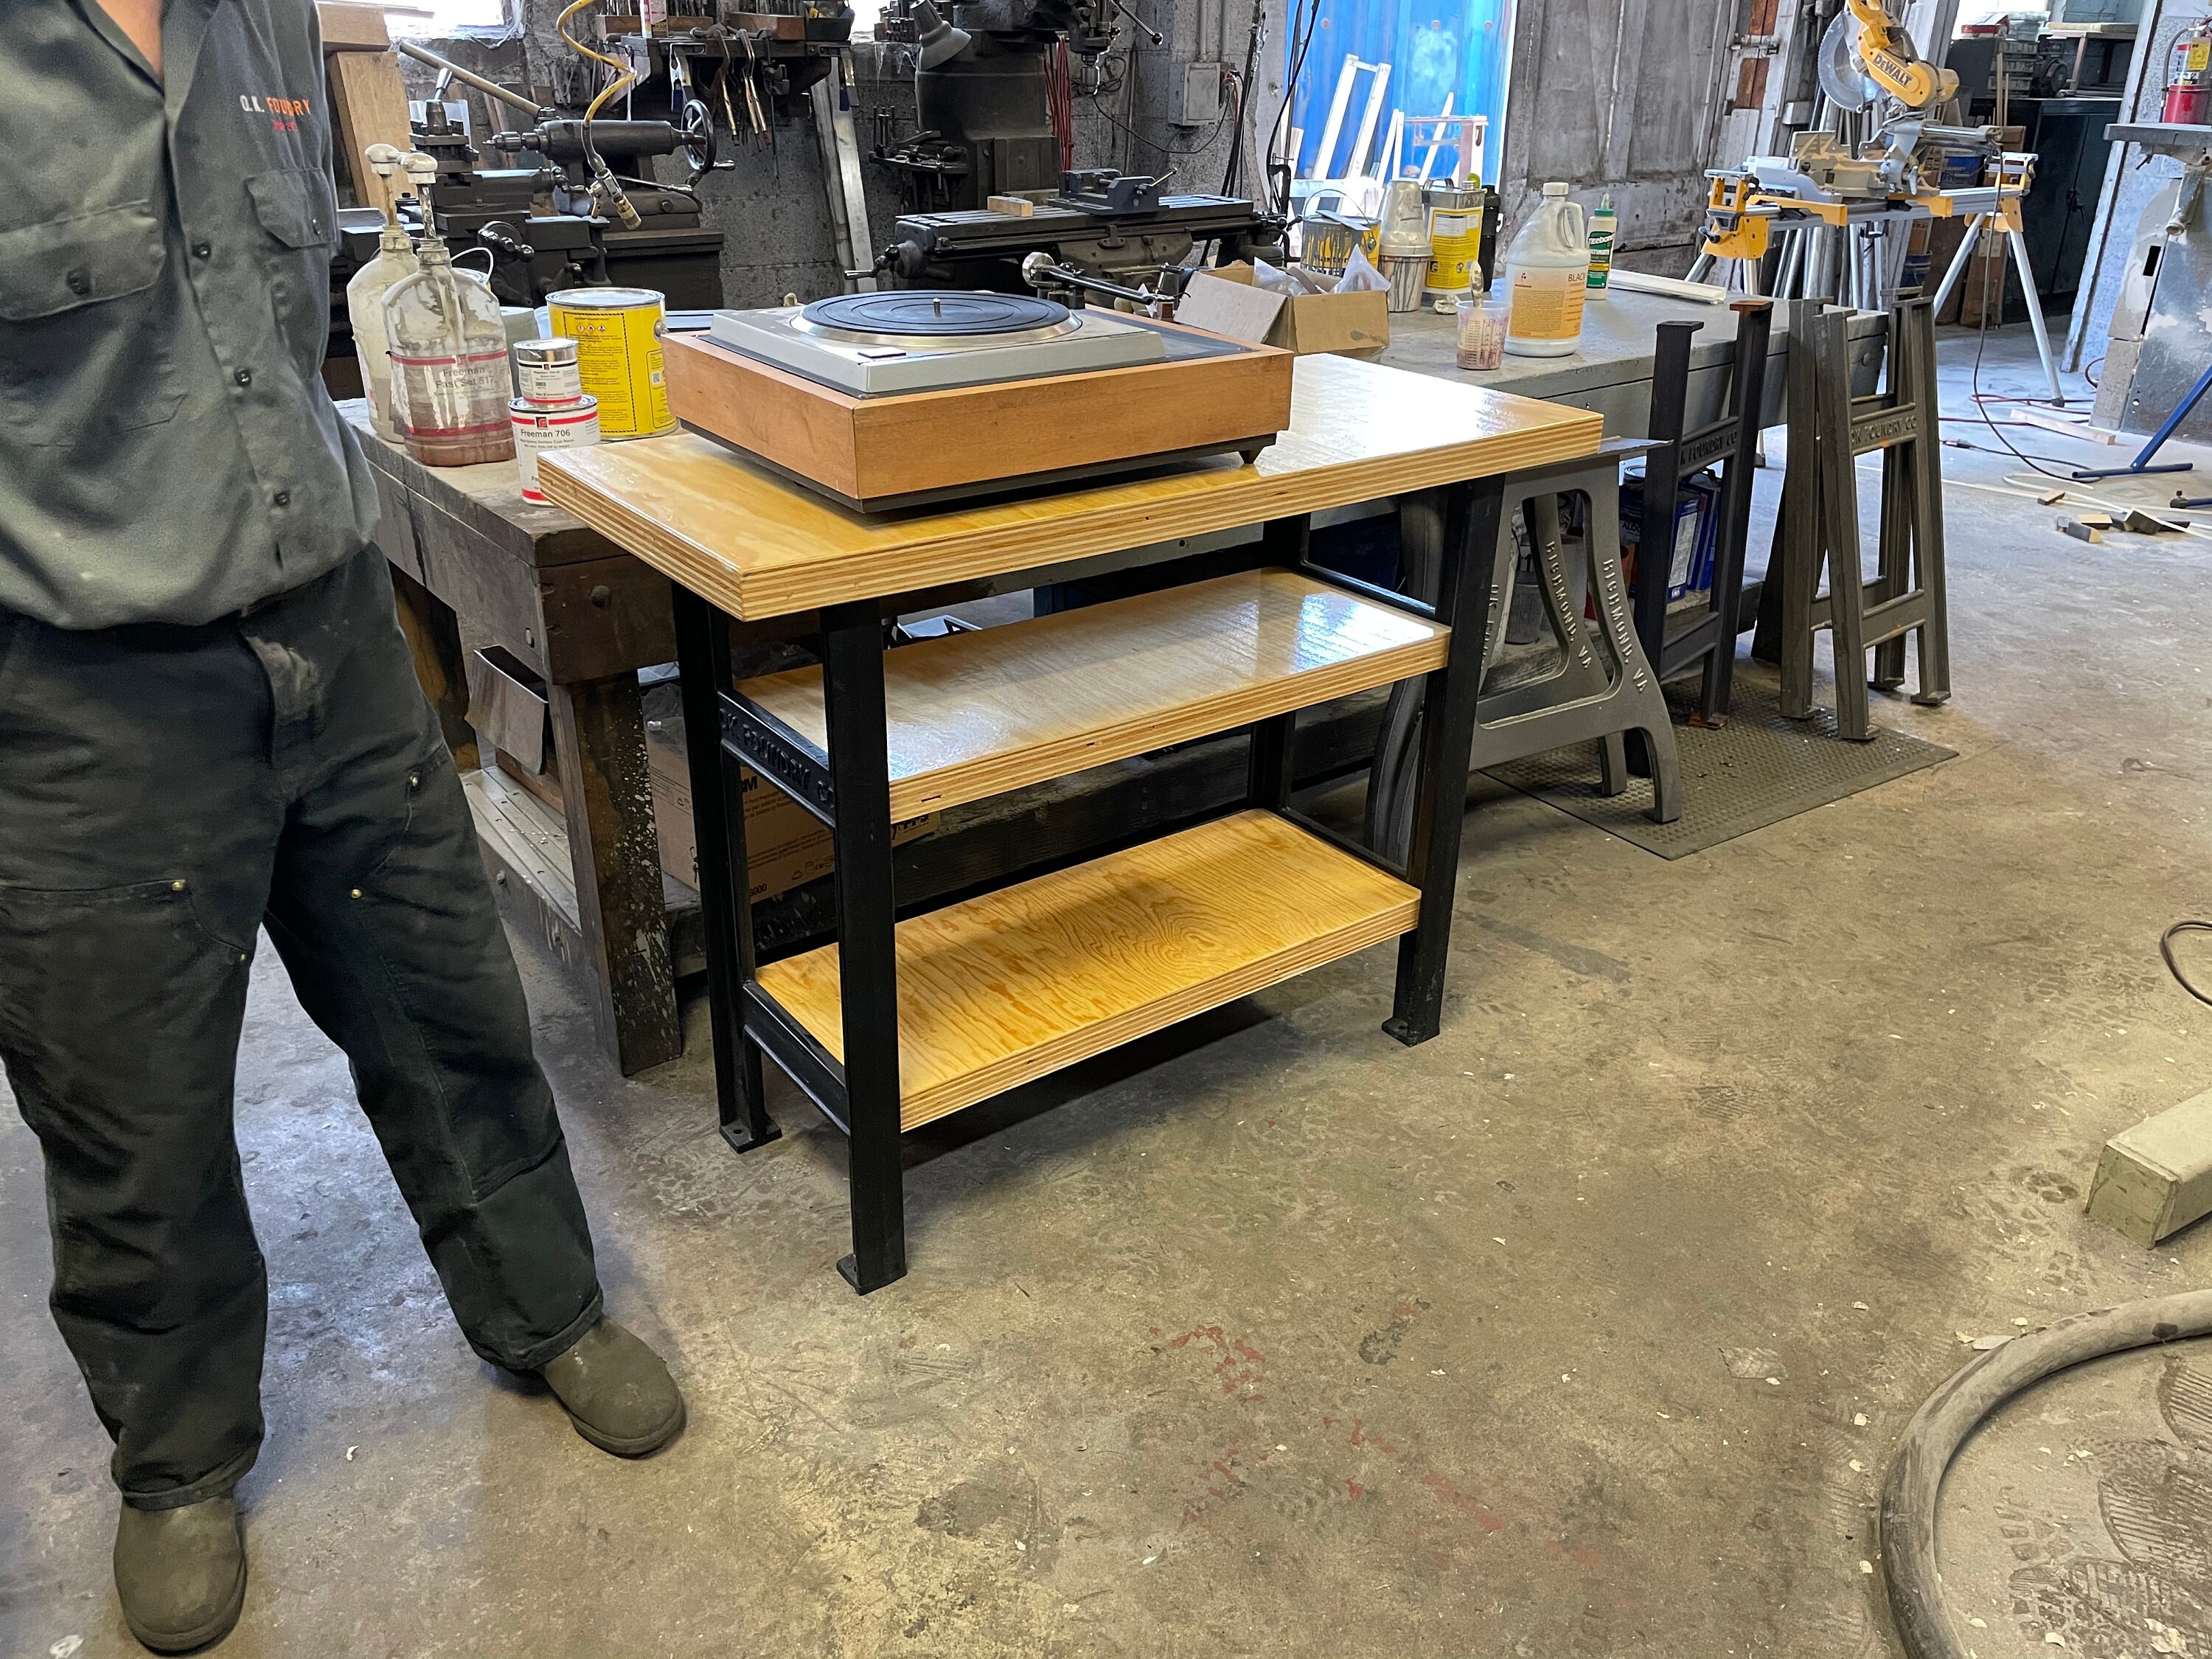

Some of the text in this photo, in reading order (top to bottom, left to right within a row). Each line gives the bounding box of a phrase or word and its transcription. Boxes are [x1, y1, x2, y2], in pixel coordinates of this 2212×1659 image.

[520, 428, 553, 437] Freeman
[742, 723, 810, 790] FOUNDRY
[818, 779, 835, 809] CO
